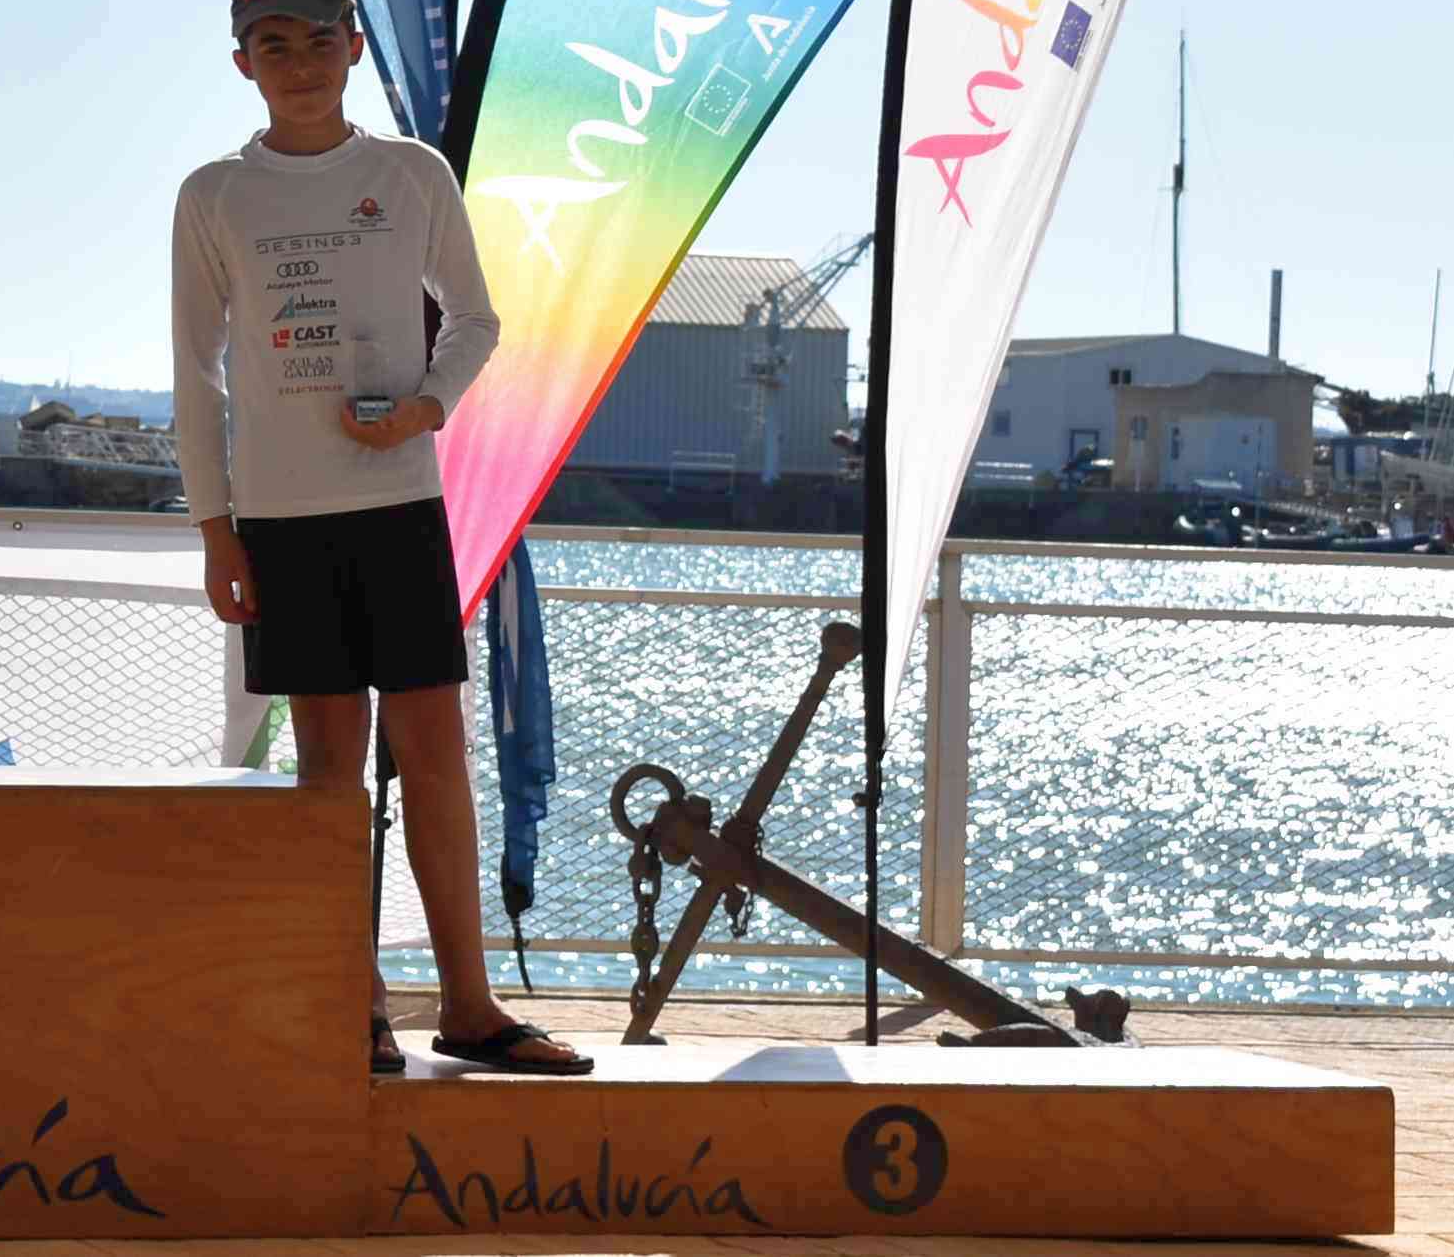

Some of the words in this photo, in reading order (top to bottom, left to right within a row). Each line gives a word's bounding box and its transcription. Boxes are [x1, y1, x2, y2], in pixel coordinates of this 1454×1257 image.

[294, 293, 337, 311] elektra
[294, 324, 337, 341] CAST
[390, 1132, 773, 1230] Andalucía
[873, 1120, 918, 1201] 3
